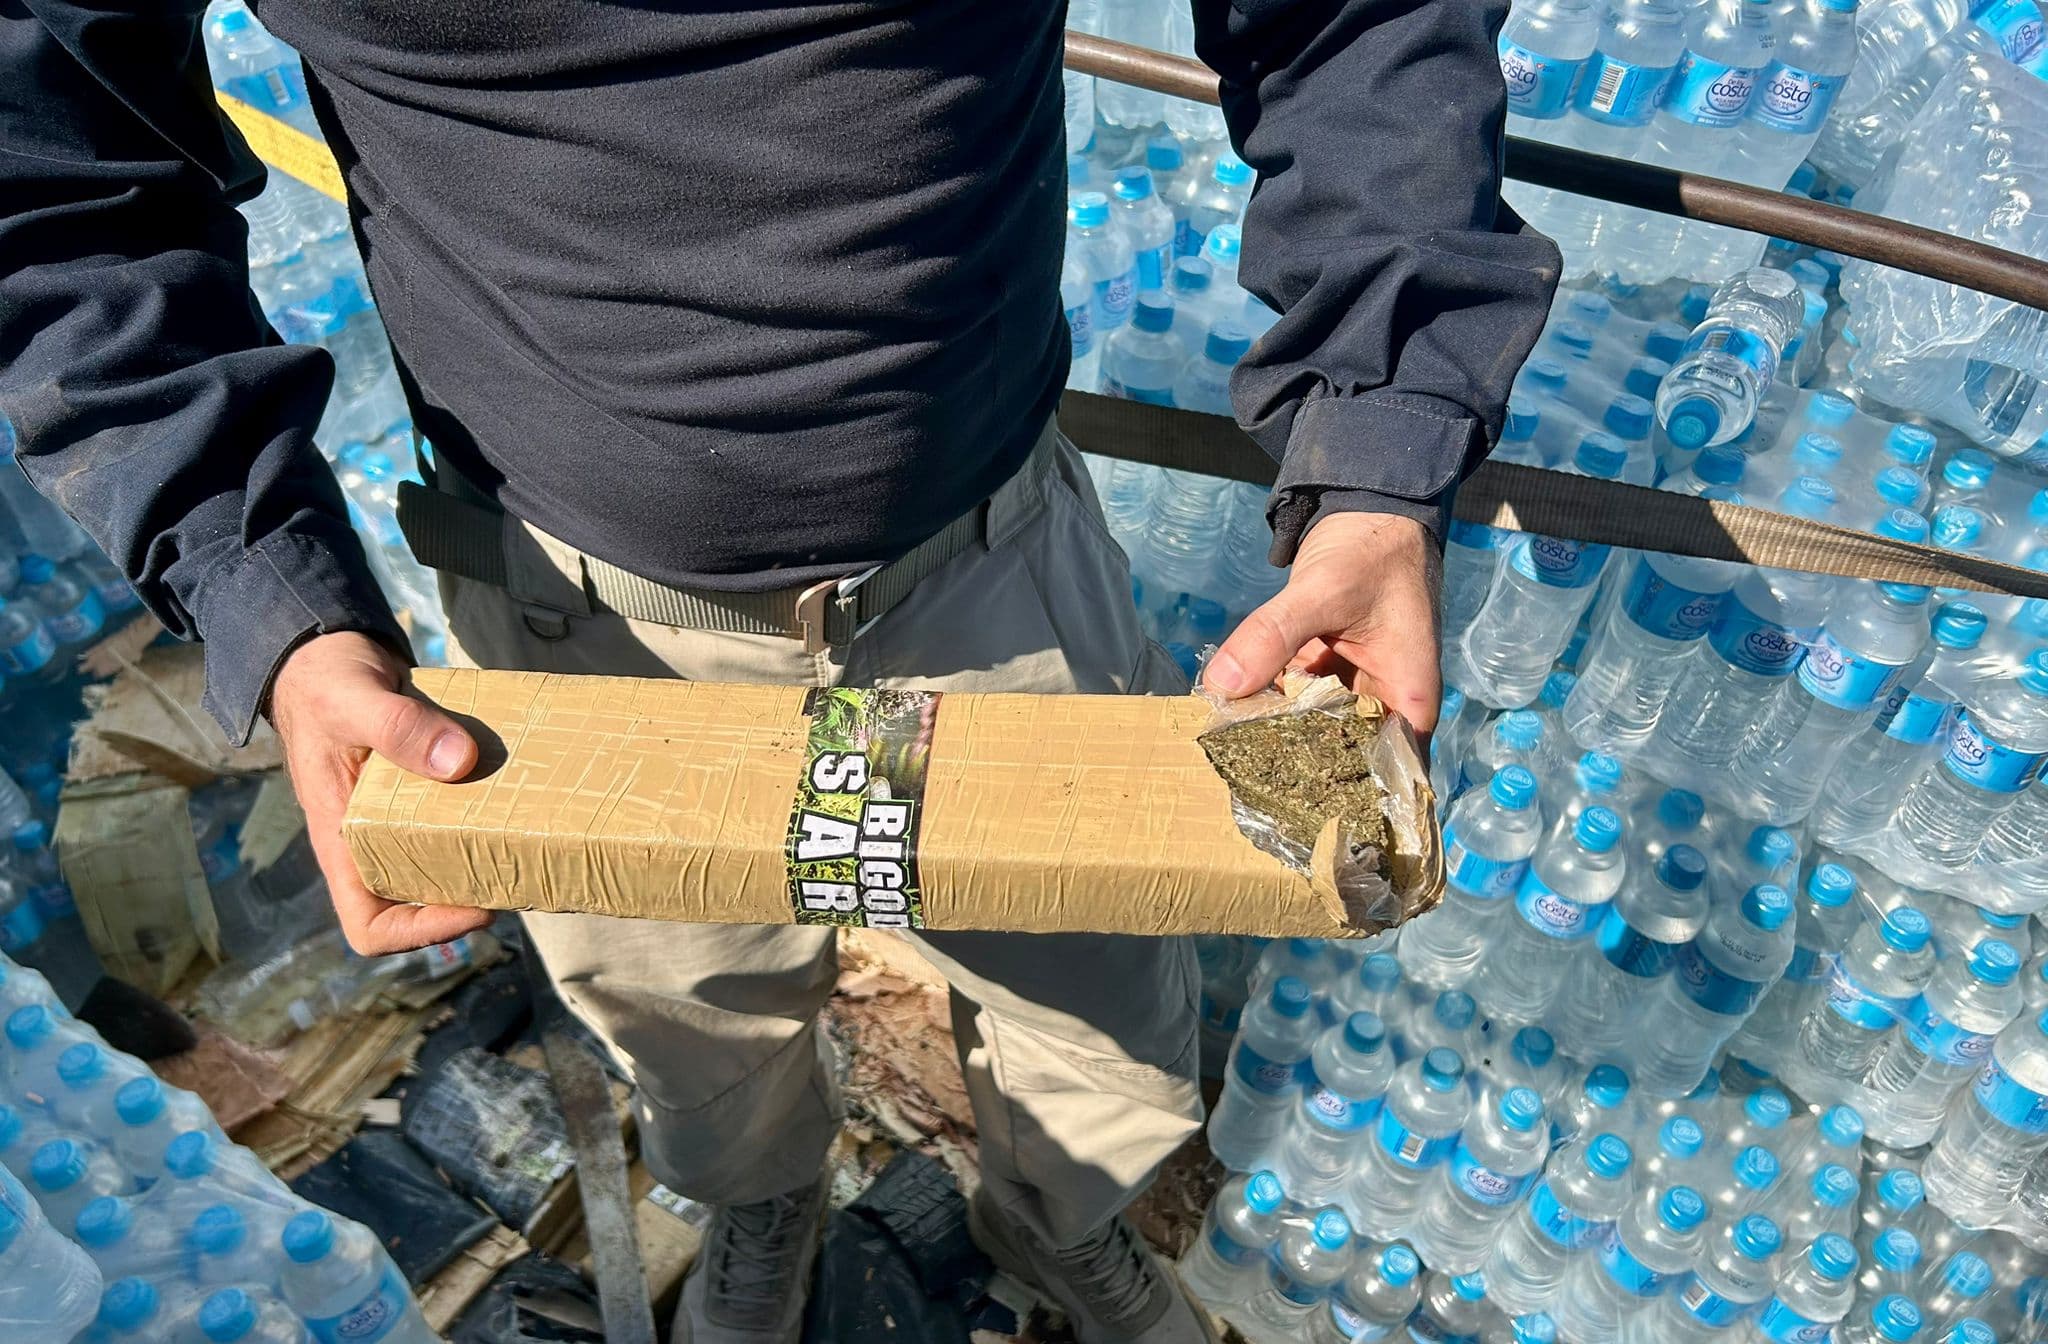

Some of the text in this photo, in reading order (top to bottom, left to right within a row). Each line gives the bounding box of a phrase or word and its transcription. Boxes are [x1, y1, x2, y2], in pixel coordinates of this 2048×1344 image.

[1766, 80, 1812, 103] costa
[1532, 538, 1578, 563] costa
[1681, 605, 1716, 617] cos
[1749, 632, 1799, 652] costa
[796, 752, 868, 911] SAR
